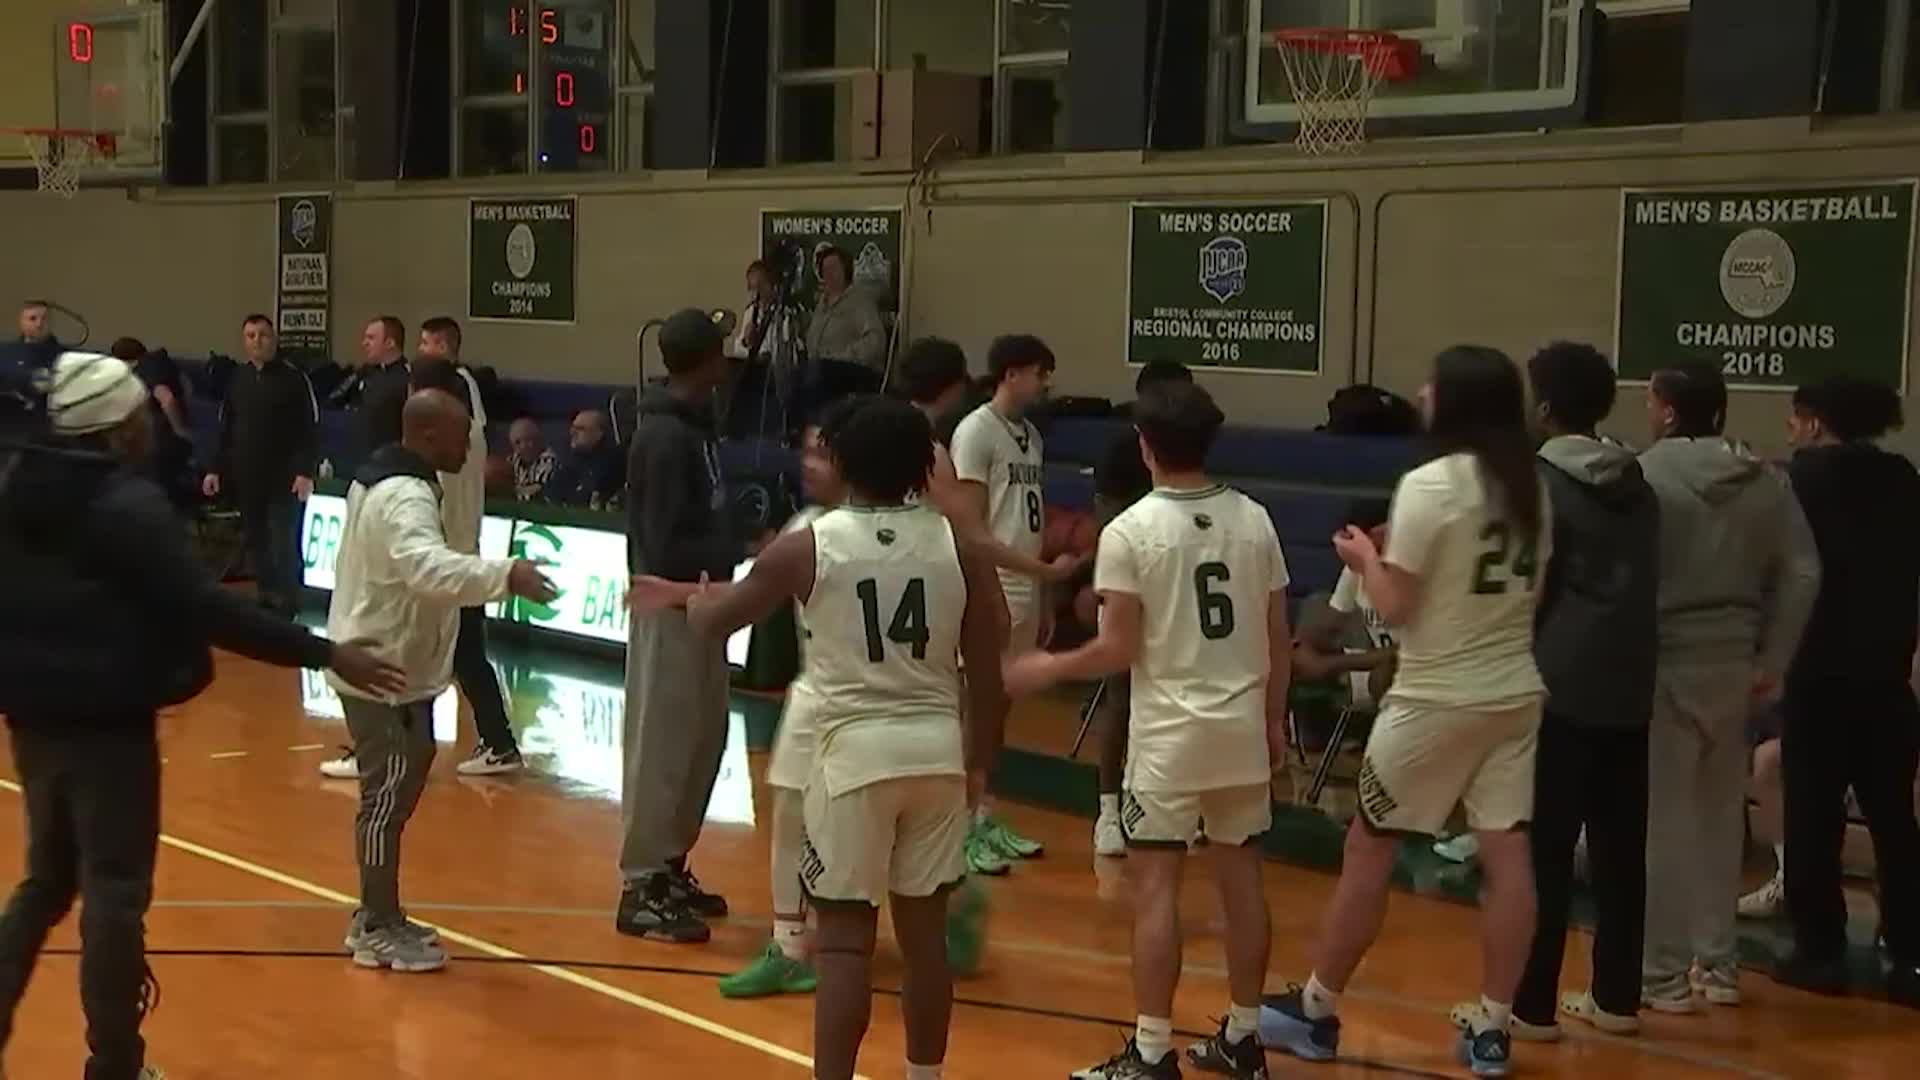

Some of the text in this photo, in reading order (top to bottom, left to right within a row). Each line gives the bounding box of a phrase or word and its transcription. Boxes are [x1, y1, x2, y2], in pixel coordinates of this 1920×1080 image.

[69, 24, 94, 63] 0
[555, 71, 575, 107] 0
[579, 125, 596, 152] 0
[505, 204, 571, 220] BASKETBALL
[1636, 195, 1898, 224] MEN'S BASKETBALL
[772, 217, 889, 236] WOMEN'S SOCCER
[1159, 212, 1292, 233] MEN'S SOCCER
[491, 281, 552, 297] CHAMPIONS
[510, 299, 533, 313] 2014
[1153, 307, 1293, 321] BRISTOL COMMUNITY COLLEGE
[1133, 319, 1316, 341] REGIONAL CHAMPIONS
[1676, 323, 1836, 348] CHAMPIONS
[1202, 342, 1240, 360] 2016
[1723, 352, 1785, 376] 2018
[1027, 490, 1040, 533] 8
[1473, 521, 1538, 595] 24
[1195, 562, 1234, 640] 6
[856, 577, 930, 662] 14
